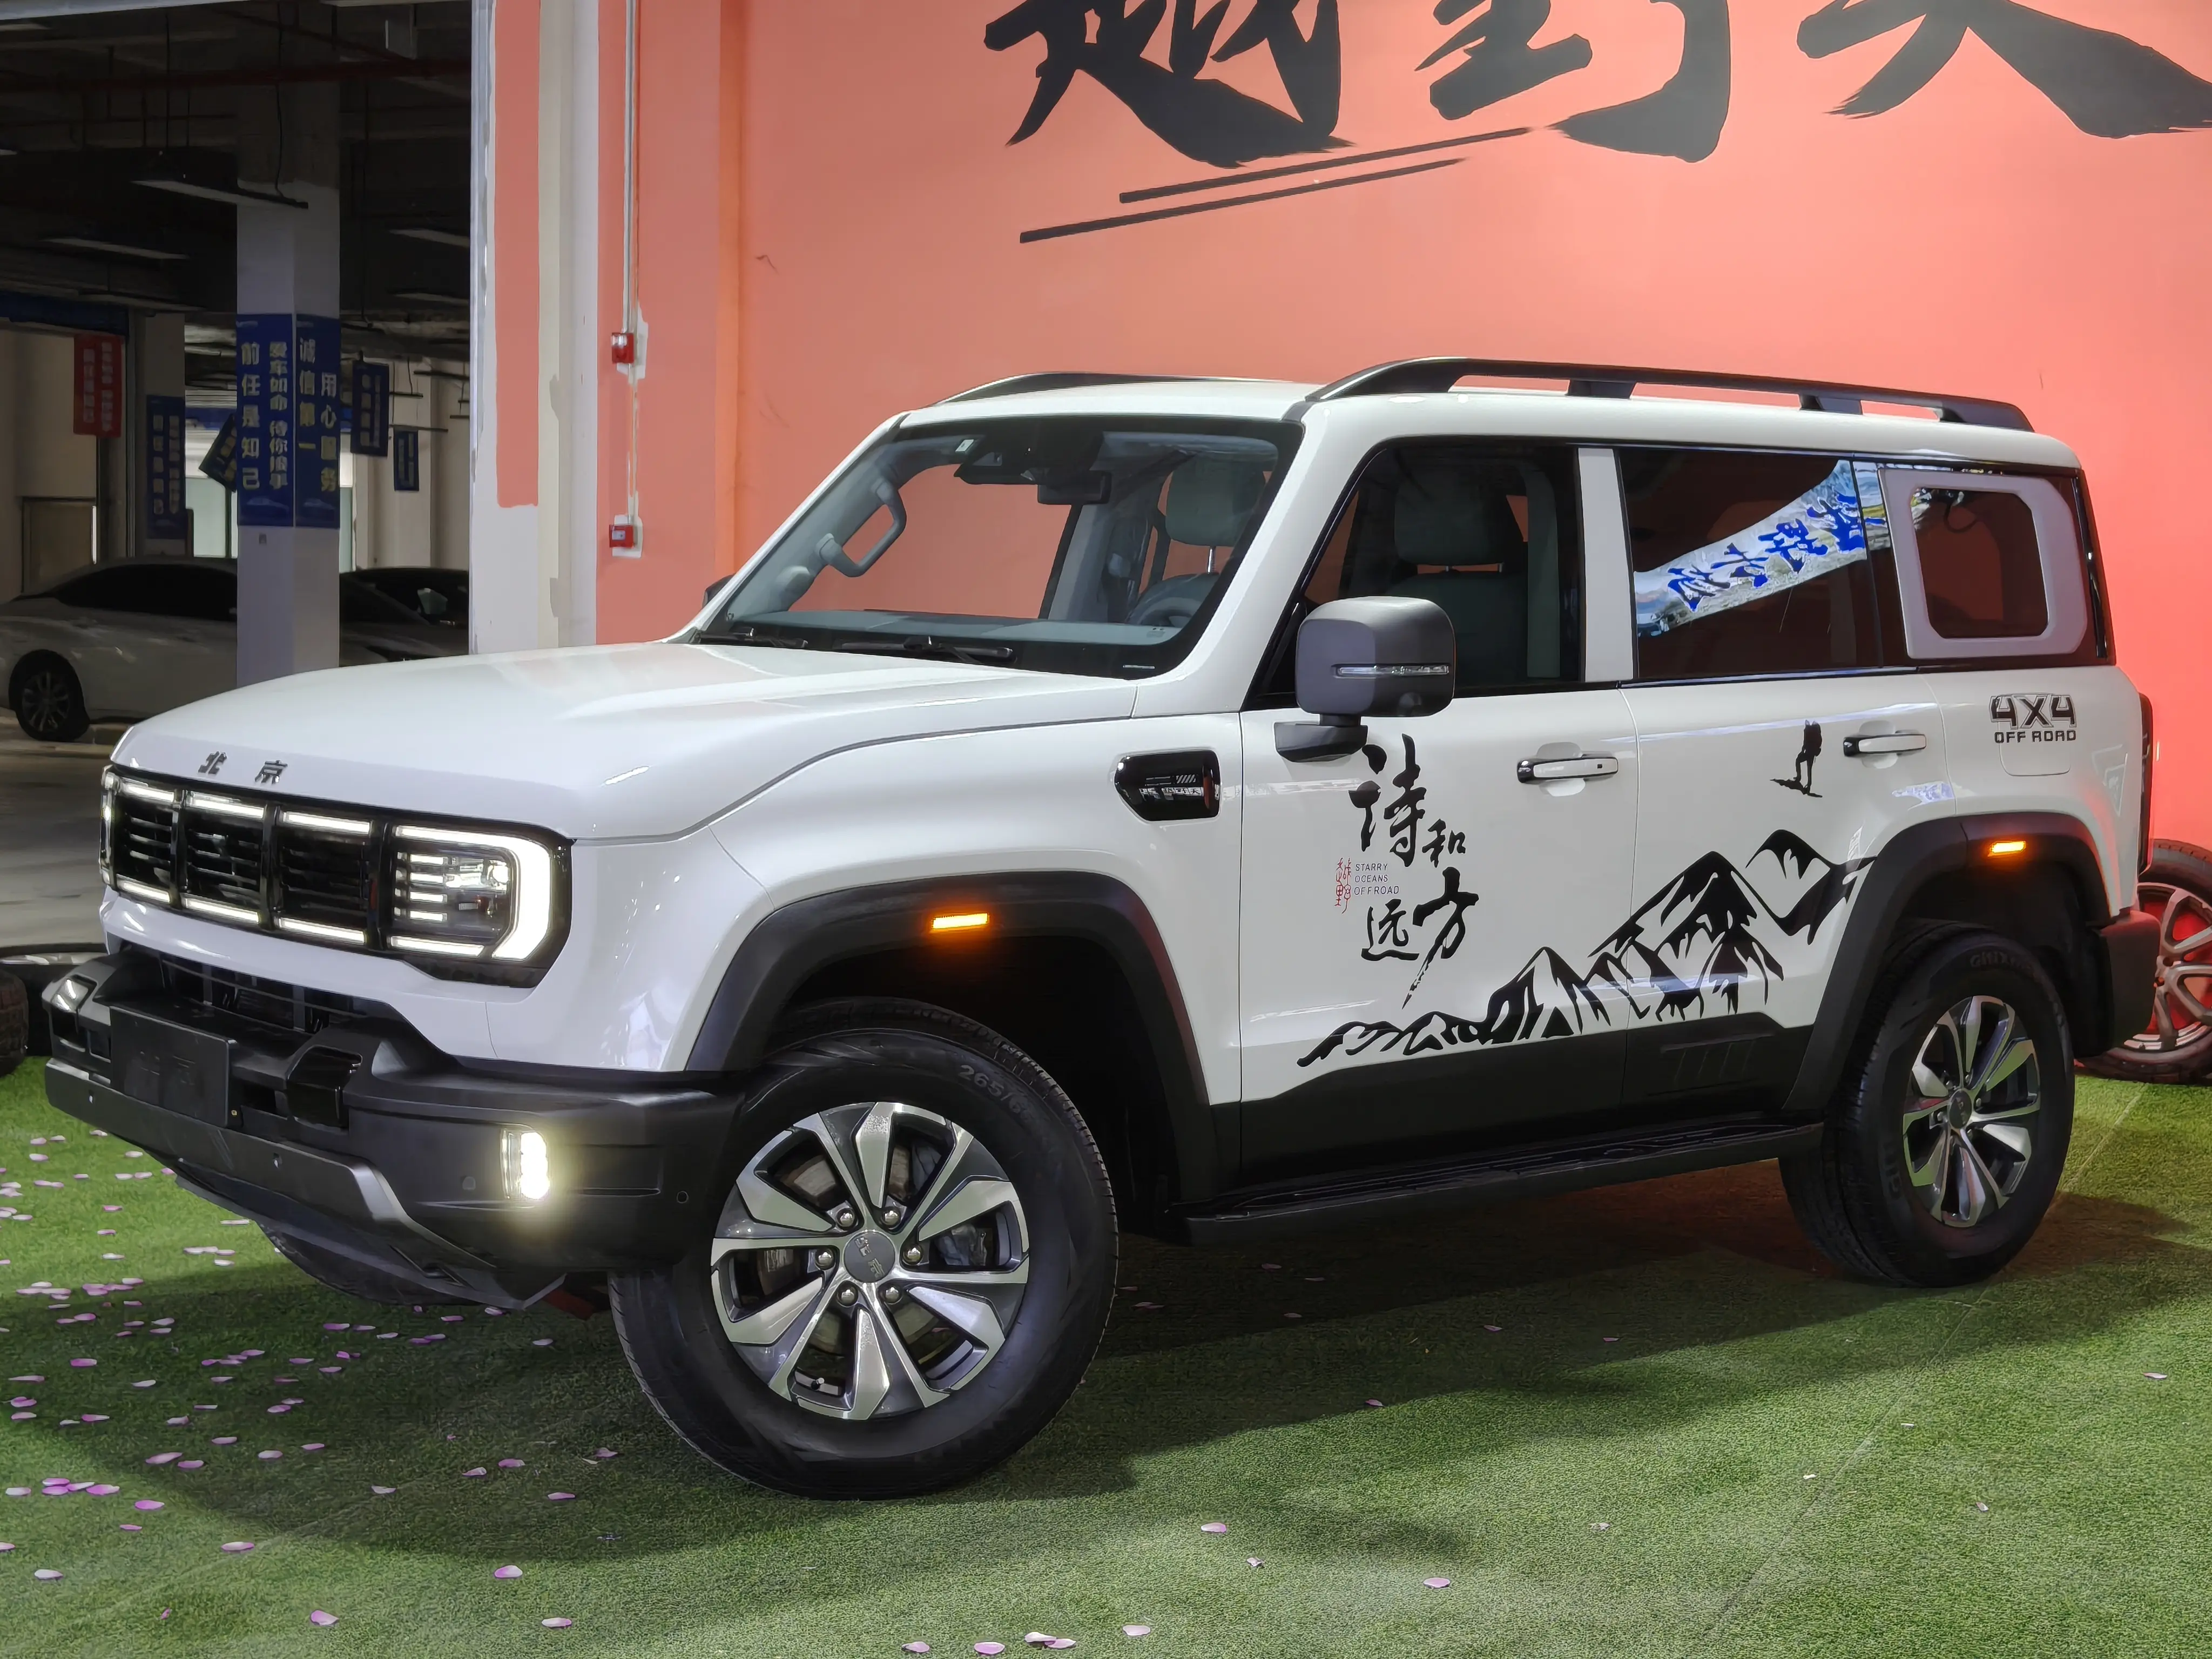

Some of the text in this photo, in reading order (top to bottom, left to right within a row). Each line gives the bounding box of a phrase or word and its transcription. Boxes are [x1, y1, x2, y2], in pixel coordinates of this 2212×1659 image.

[299, 337, 316, 449] 诚信一
[241, 341, 260, 490] 前任是知己
[321, 372, 337, 492] 用心务
[1989, 693, 2076, 729] 4X4
[1994, 730, 2076, 743] OFF ROAD
[198, 751, 288, 785] 北京
[1354, 874, 1388, 882] OCEANS
[1355, 864, 1388, 872] STARRY
